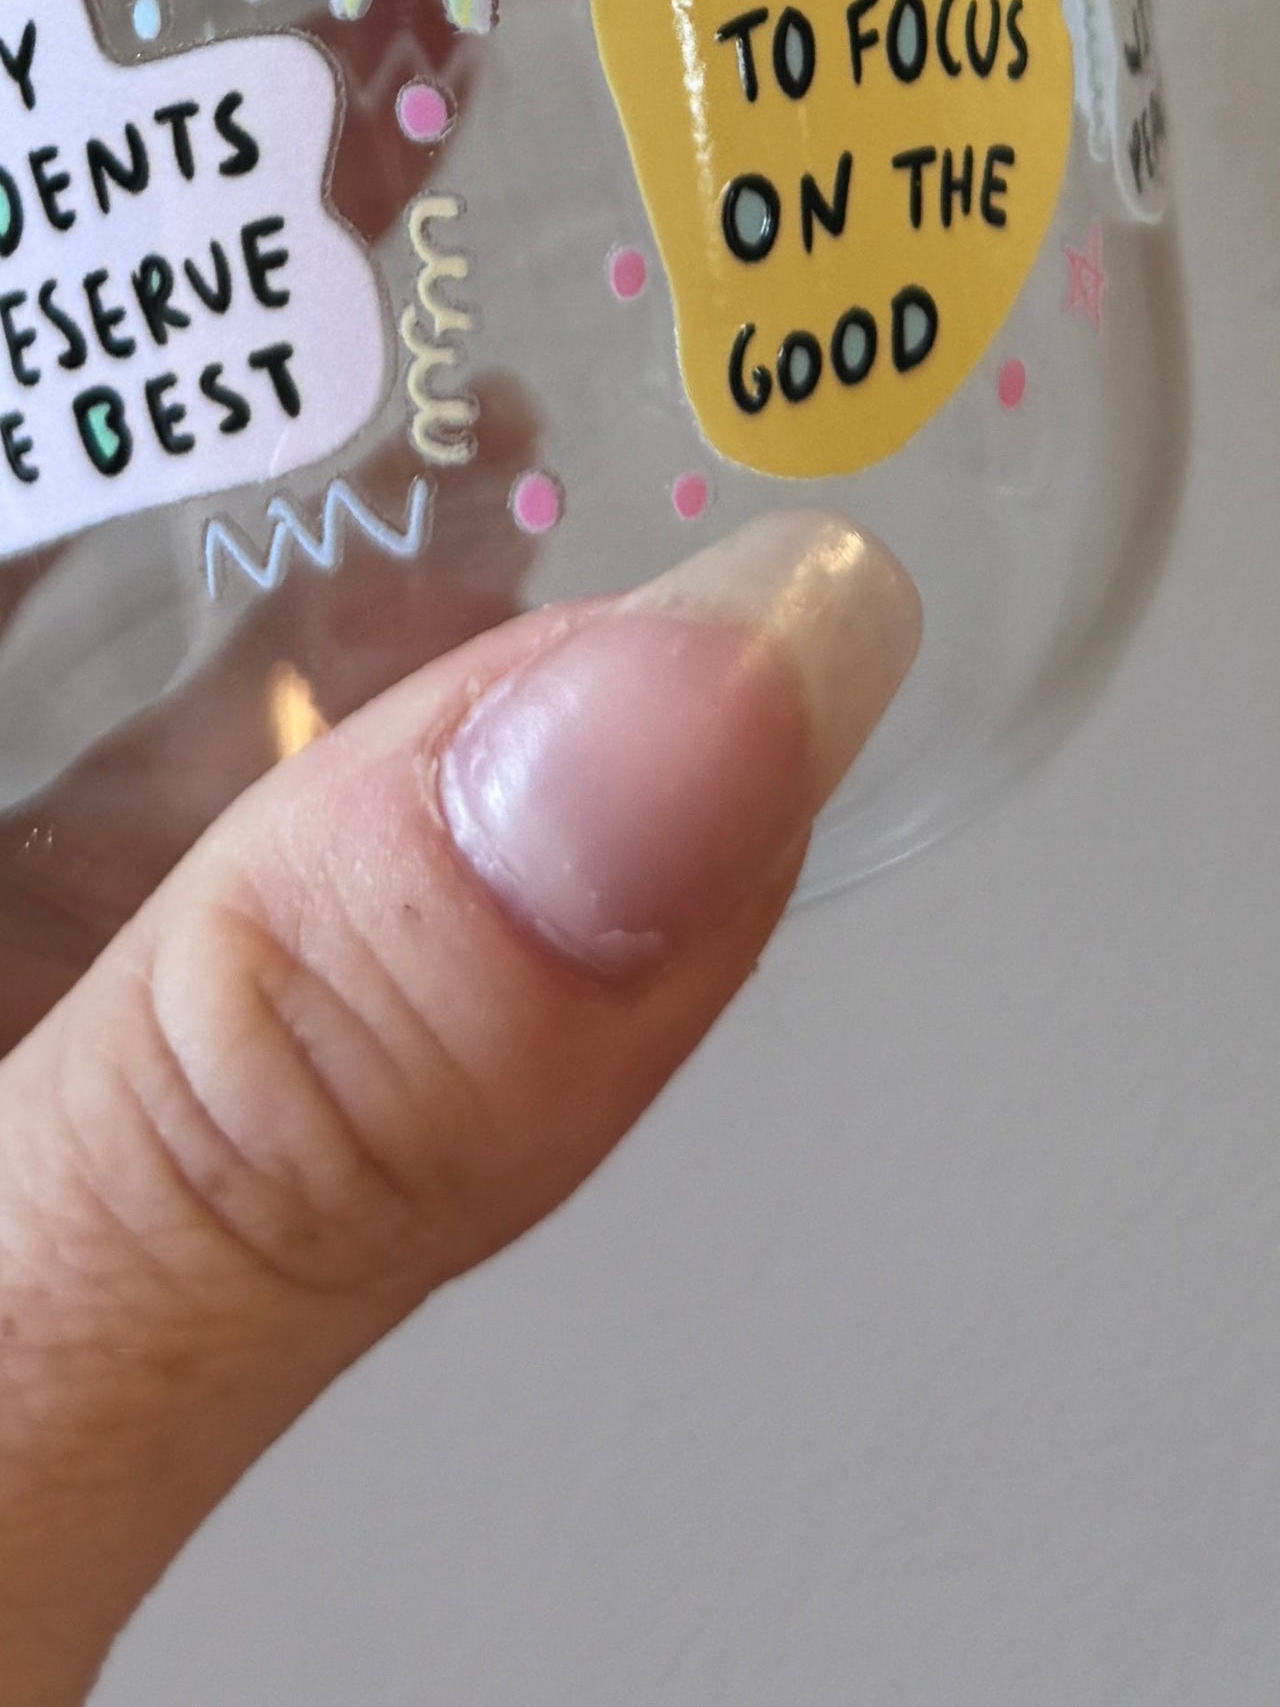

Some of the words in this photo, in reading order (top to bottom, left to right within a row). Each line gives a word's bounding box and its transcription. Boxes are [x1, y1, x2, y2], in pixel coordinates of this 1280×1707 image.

[714, 6, 816, 103] TO
[721, 149, 852, 263] ON
[892, 145, 1016, 231] THE
[72, 343, 303, 476] BEST
[728, 284, 938, 415] GOOD
